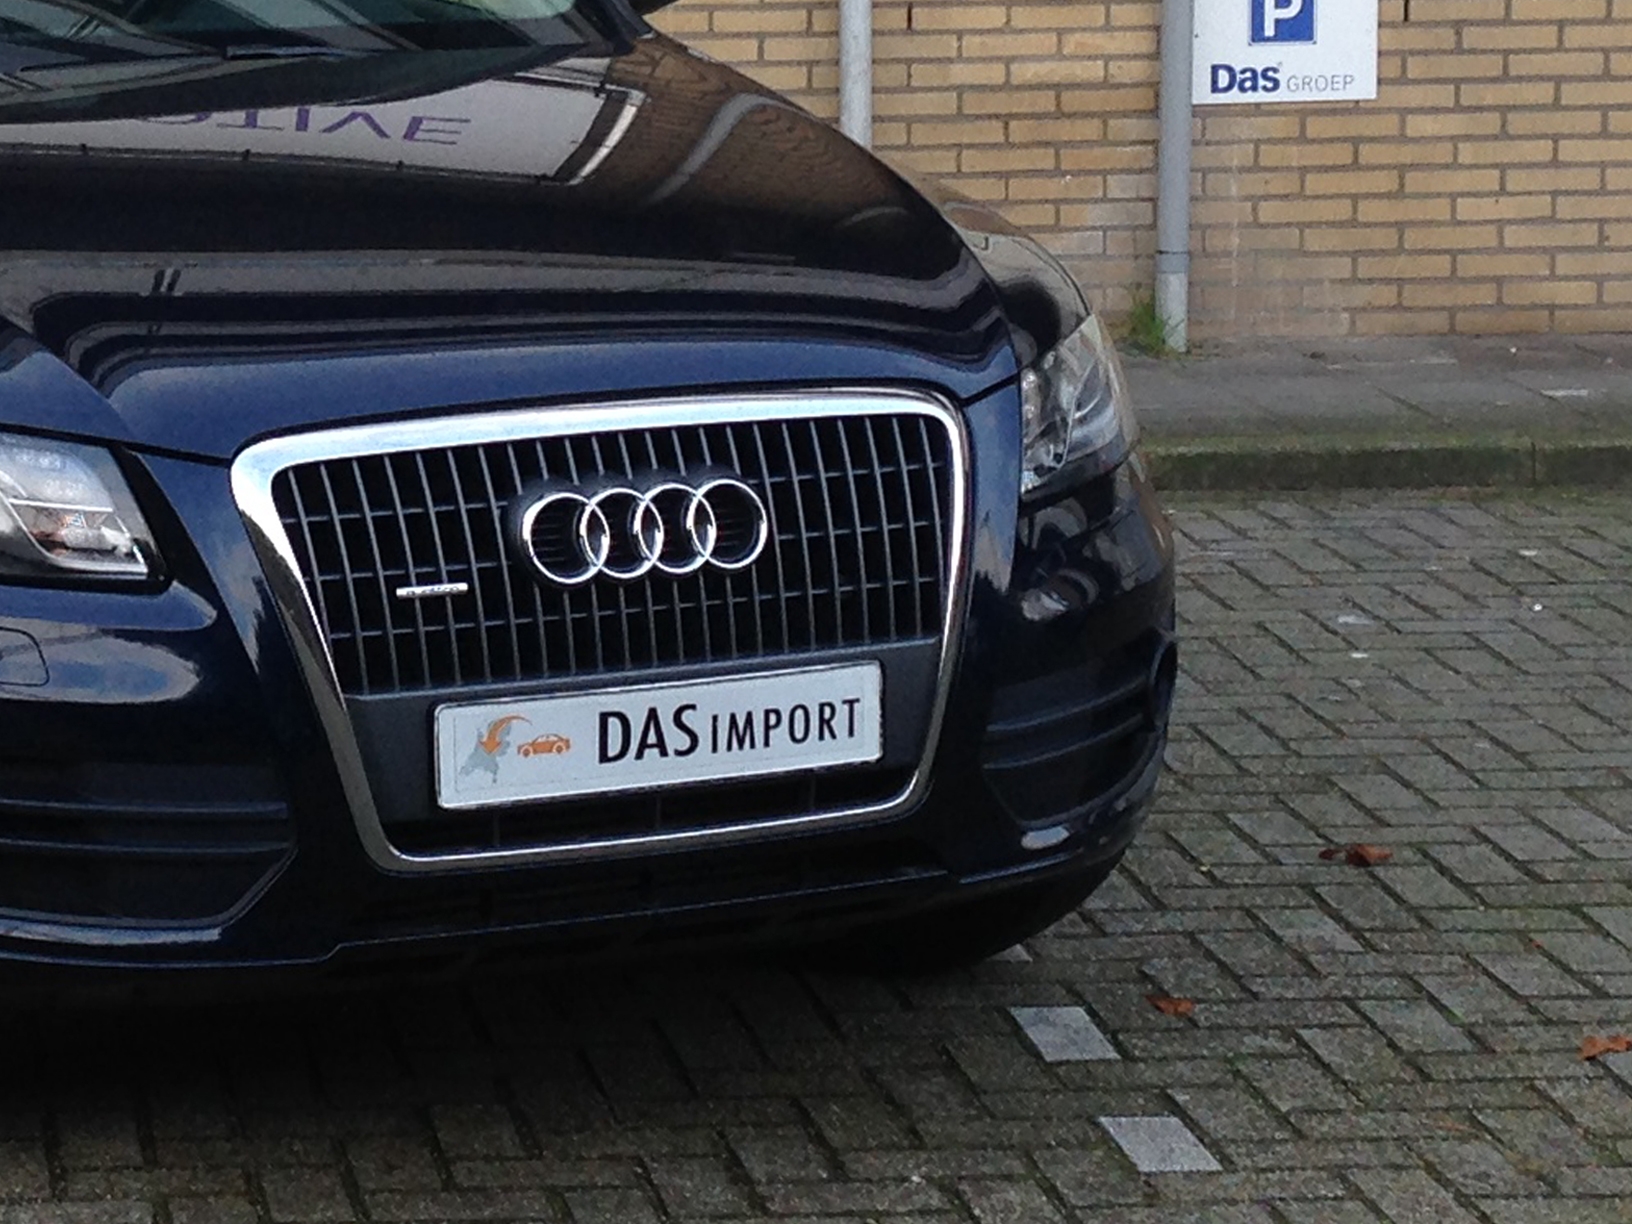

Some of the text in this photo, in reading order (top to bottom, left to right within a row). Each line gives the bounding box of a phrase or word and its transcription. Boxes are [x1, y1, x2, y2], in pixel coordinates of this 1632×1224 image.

[1210, 64, 1355, 94] Das GROEP
[597, 696, 862, 765] DAS IMPORT
